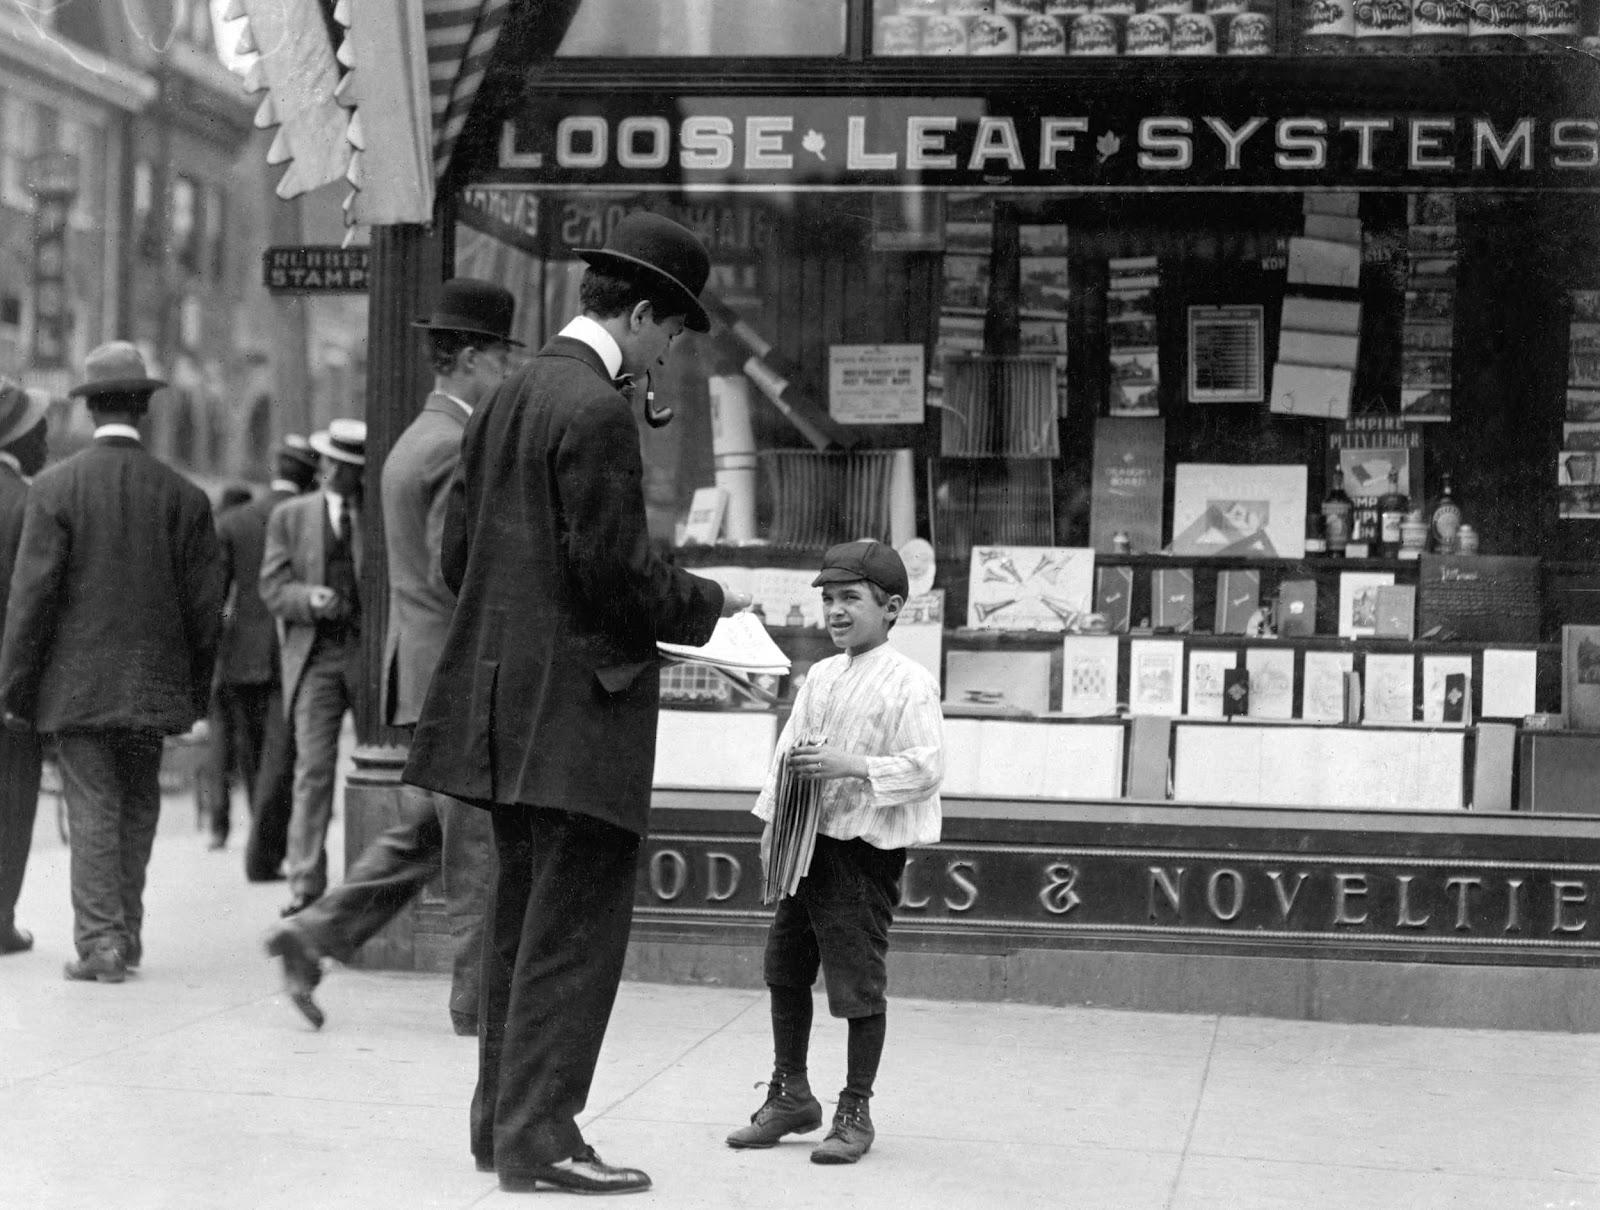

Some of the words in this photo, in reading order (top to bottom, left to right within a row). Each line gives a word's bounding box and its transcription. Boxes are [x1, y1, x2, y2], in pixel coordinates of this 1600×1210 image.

[499, 116, 793, 169] LOOSE
[846, 116, 1089, 170] LEAF
[1137, 117, 1600, 170] SYSTEMS
[273, 252, 368, 267] RUBBE
[1039, 863, 1080, 913] &
[1150, 867, 1588, 932] NOVELTIE
